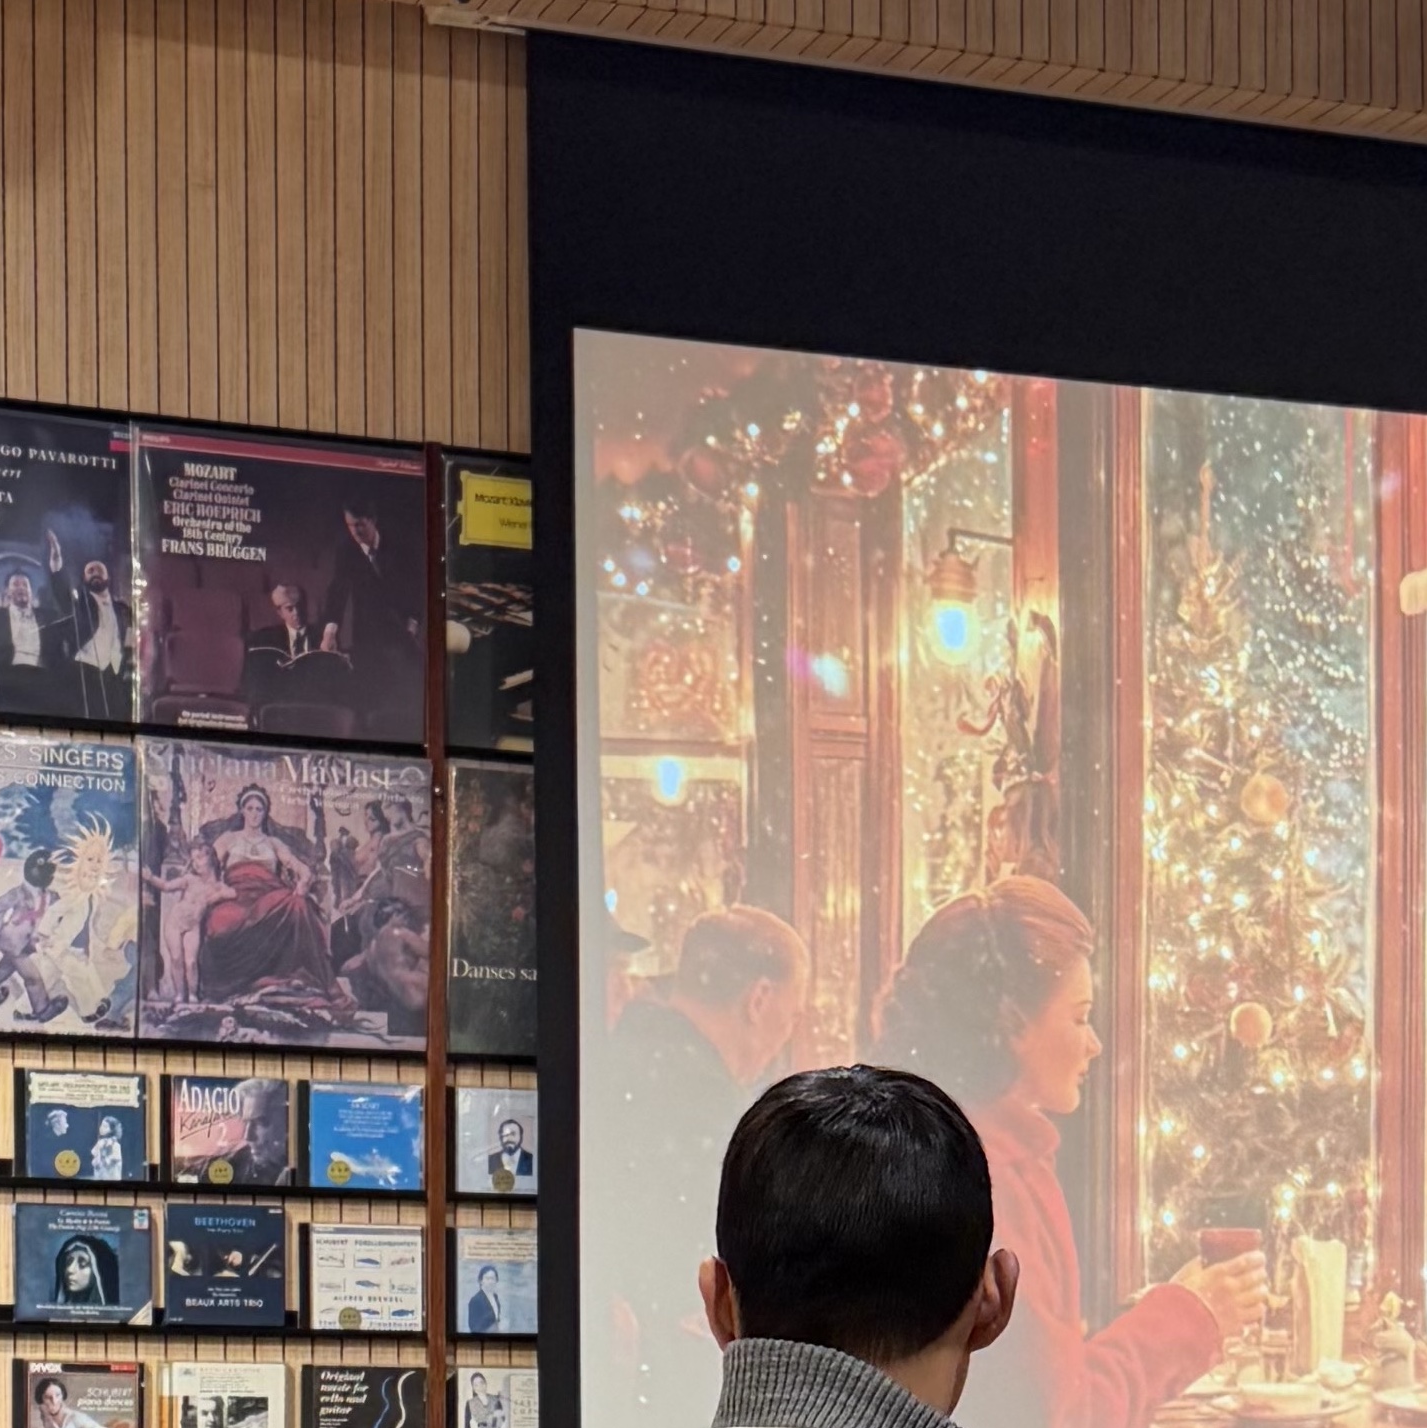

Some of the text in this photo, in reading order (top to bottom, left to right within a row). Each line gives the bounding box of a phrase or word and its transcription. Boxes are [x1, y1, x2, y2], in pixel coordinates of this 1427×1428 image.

[28, 448, 118, 470] PAVAROTTI
[184, 462, 237, 480] MOZART
[169, 476, 254, 495] Clarinet Concerto
[173, 489, 249, 506] Clarinet Quintet
[164, 500, 261, 523] ERIC HOEPRICH
[172, 515, 251, 533] Orchestra of the
[162, 538, 203, 555] FRANS
[204, 530, 242, 546] Century
[29, 746, 124, 770] SINGERS
[14, 771, 125, 792] CONNECTION
[452, 957, 516, 981] Danses
[180, 1078, 242, 1114] ADAGIO
[194, 1217, 256, 1227] BEETHOVEN
[185, 1298, 263, 1308] BEAUX ARTS TRIO
[320, 1371, 365, 1383] Original
[87, 1388, 132, 1396] SCHUBERT
[320, 1384, 369, 1395] music for
[320, 1395, 367, 1404] cello and
[319, 1406, 352, 1416] guitar
